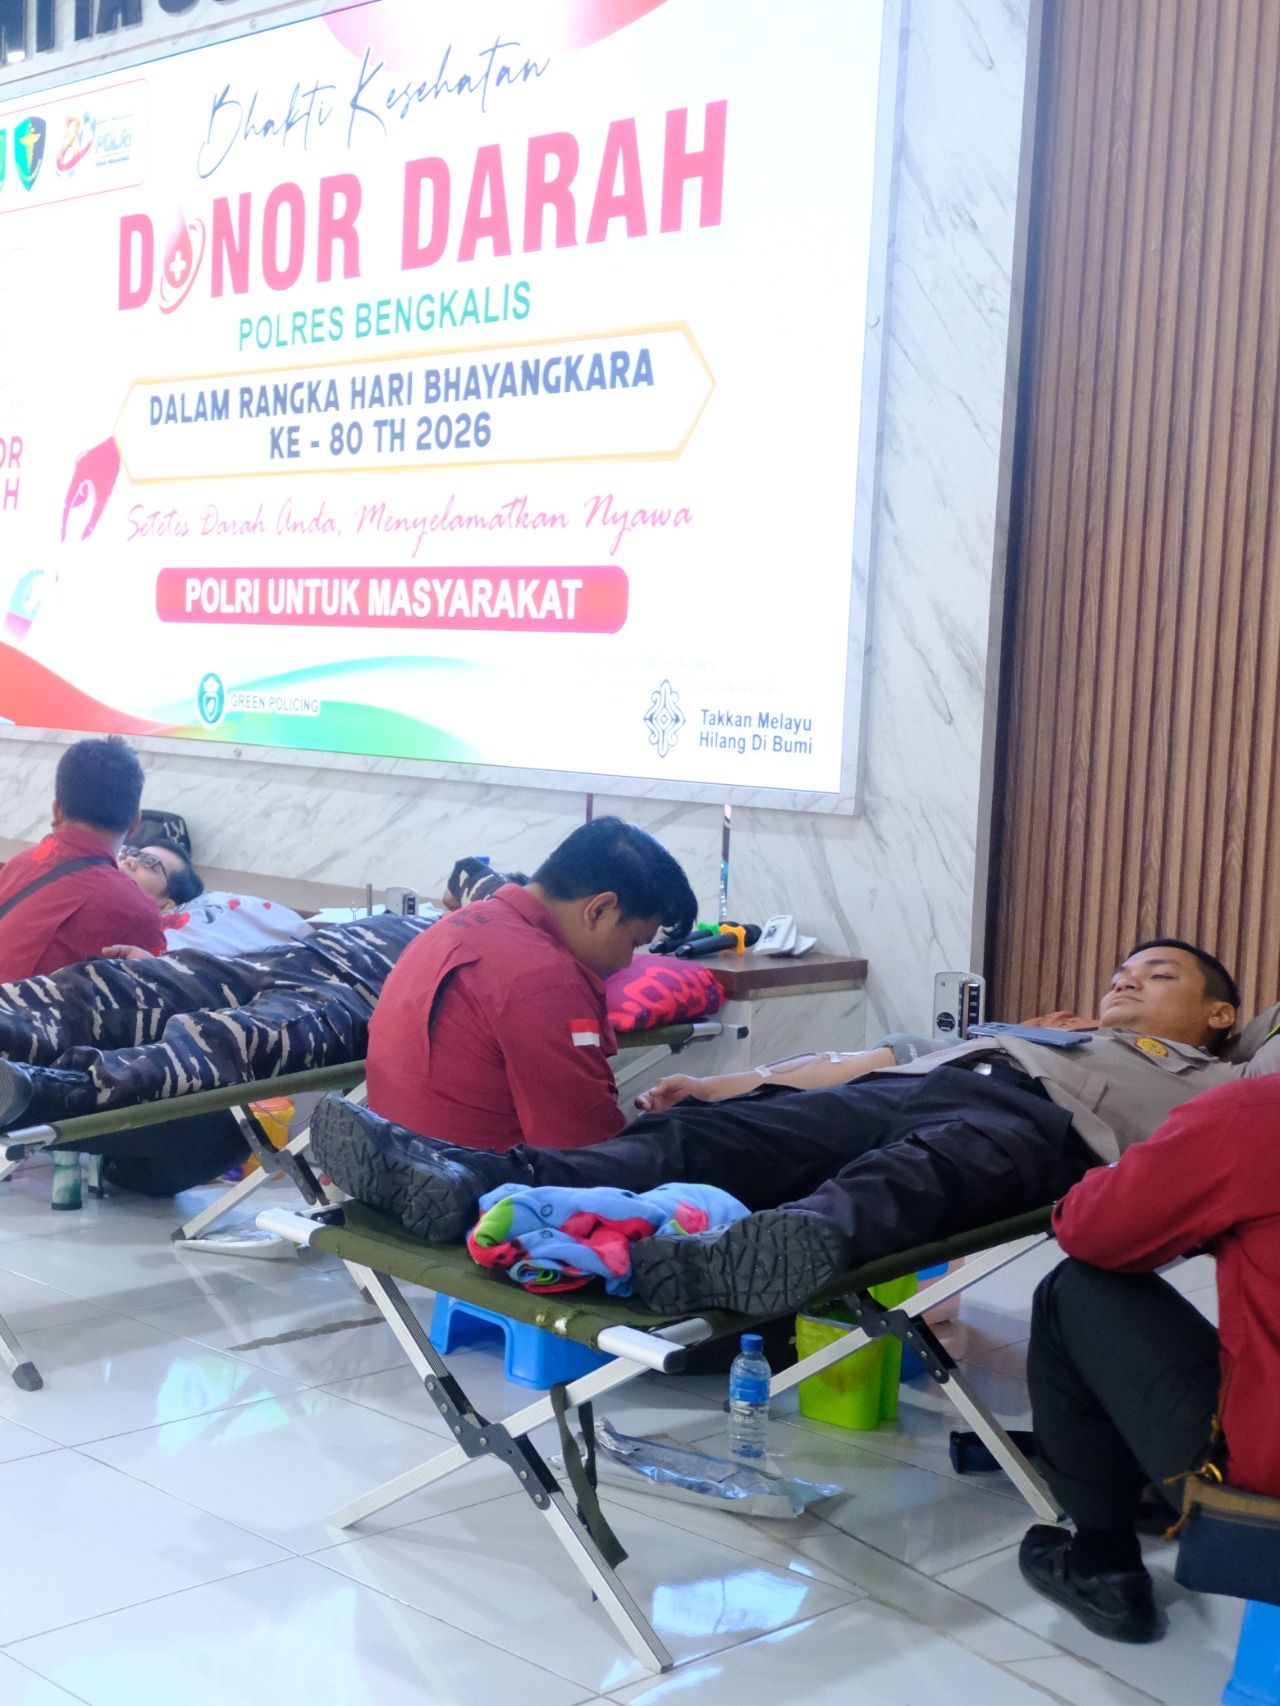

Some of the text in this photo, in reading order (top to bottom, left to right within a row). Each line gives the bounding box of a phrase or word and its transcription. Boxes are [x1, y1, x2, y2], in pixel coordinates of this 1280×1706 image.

[197, 35, 551, 180] Bhakti Kesehatan
[117, 98, 728, 315] DONOR DARAH
[238, 281, 532, 352] POLRES BENGKALIS
[150, 347, 655, 427] DALAM RANGKA HARI BHAYANGKARA
[269, 425, 301, 460] KE
[329, 421, 363, 456] 80
[373, 418, 406, 454] TH
[415, 411, 492, 451] 2026
[126, 493, 693, 558] Setetes Darah Anda, Menyelamatkan Nyawa
[185, 578, 583, 620] POLRI UNTUK MASYARAKAT
[230, 694, 319, 713] GREEN POLICING
[700, 708, 812, 734] Takkan Melayu
[699, 730, 813, 755] Hilang Di Bumi
